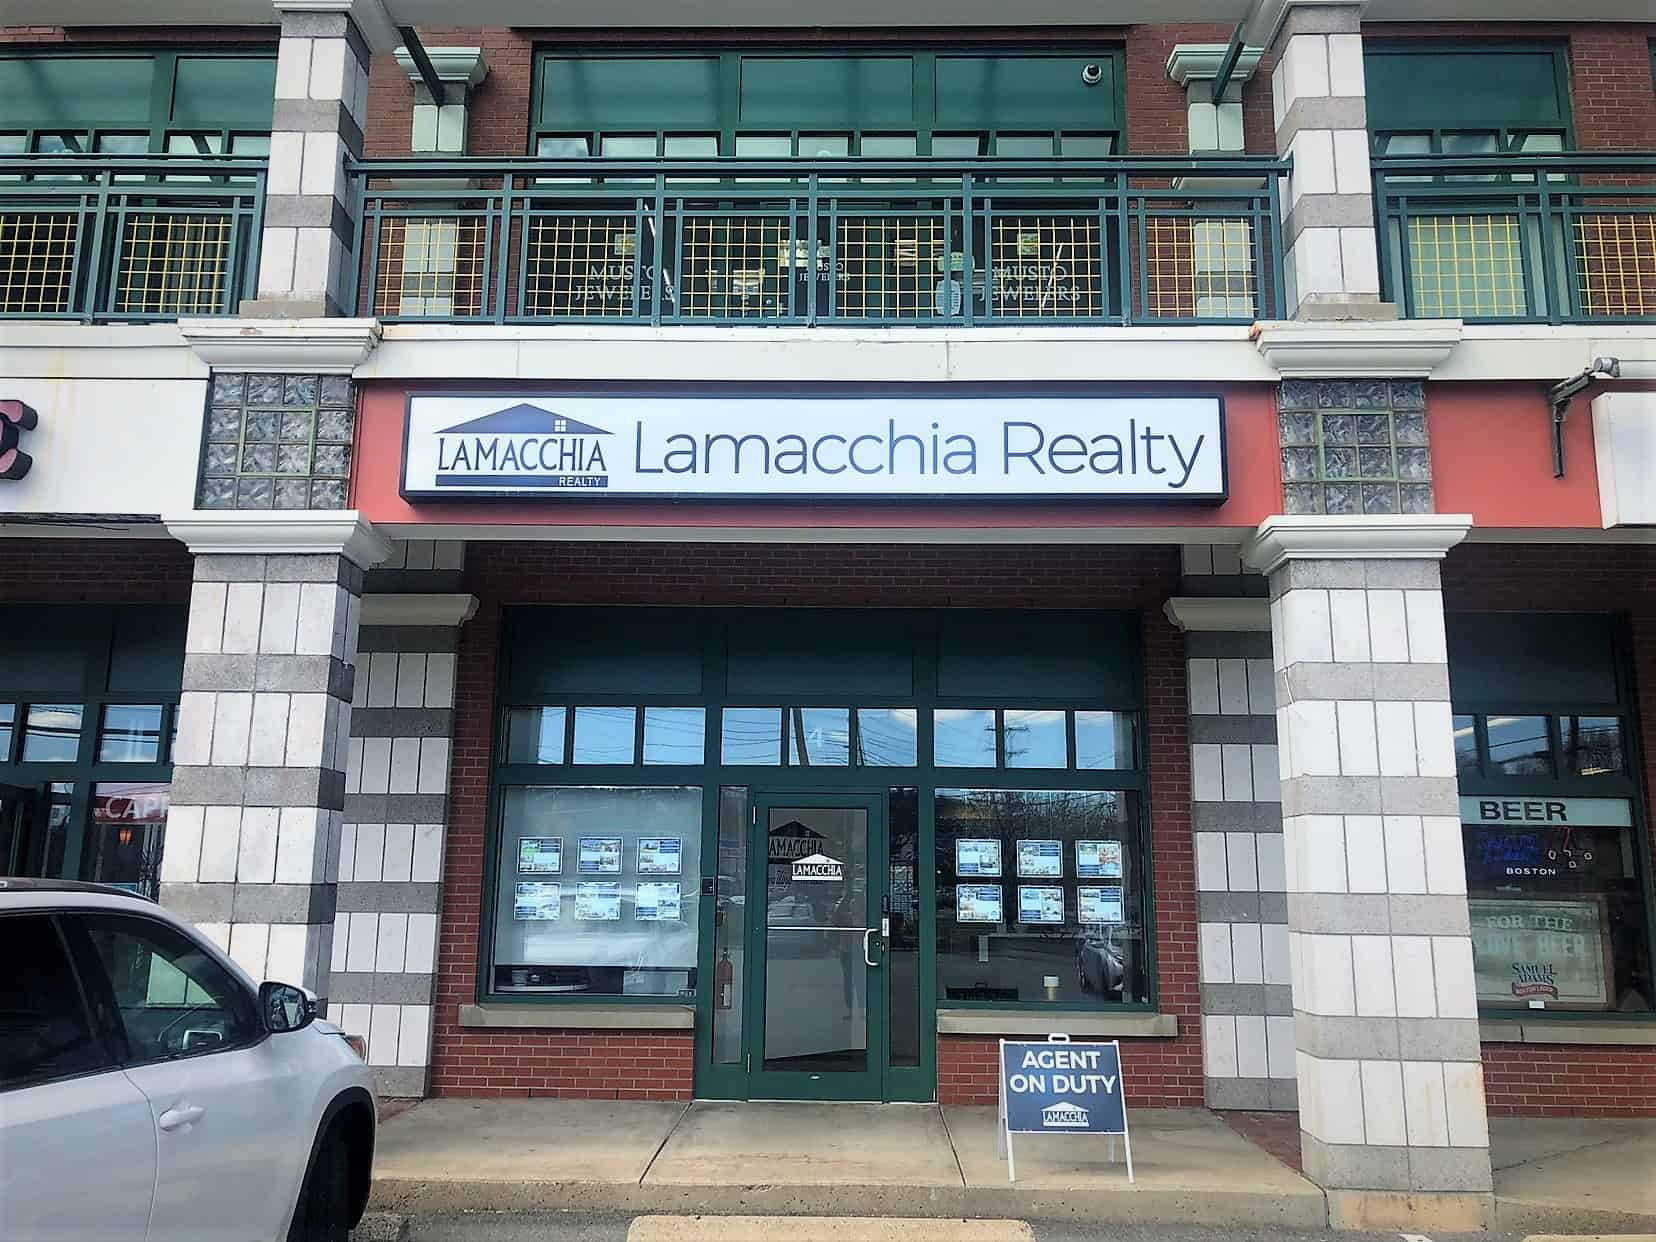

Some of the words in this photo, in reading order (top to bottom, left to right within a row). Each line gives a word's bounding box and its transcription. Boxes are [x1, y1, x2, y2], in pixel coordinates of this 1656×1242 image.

[589, 265, 655, 281] MUSO
[992, 265, 1067, 281] MUSTO
[575, 285, 675, 301] JEWEES
[438, 437, 607, 471] LAMACCHIA
[635, 418, 977, 475] Lamacchia
[1003, 418, 1205, 488] Realty
[559, 476, 601, 487] REALTY
[1479, 800, 1568, 821] BEER
[792, 864, 842, 875] LAMACCHIA
[1505, 867, 1557, 875] BOSTON
[1022, 1050, 1101, 1069] AGENT
[1009, 1074, 1046, 1093] ON
[1052, 1075, 1116, 1094] DUTY
[1042, 1111, 1088, 1123] LAMACCHIA
